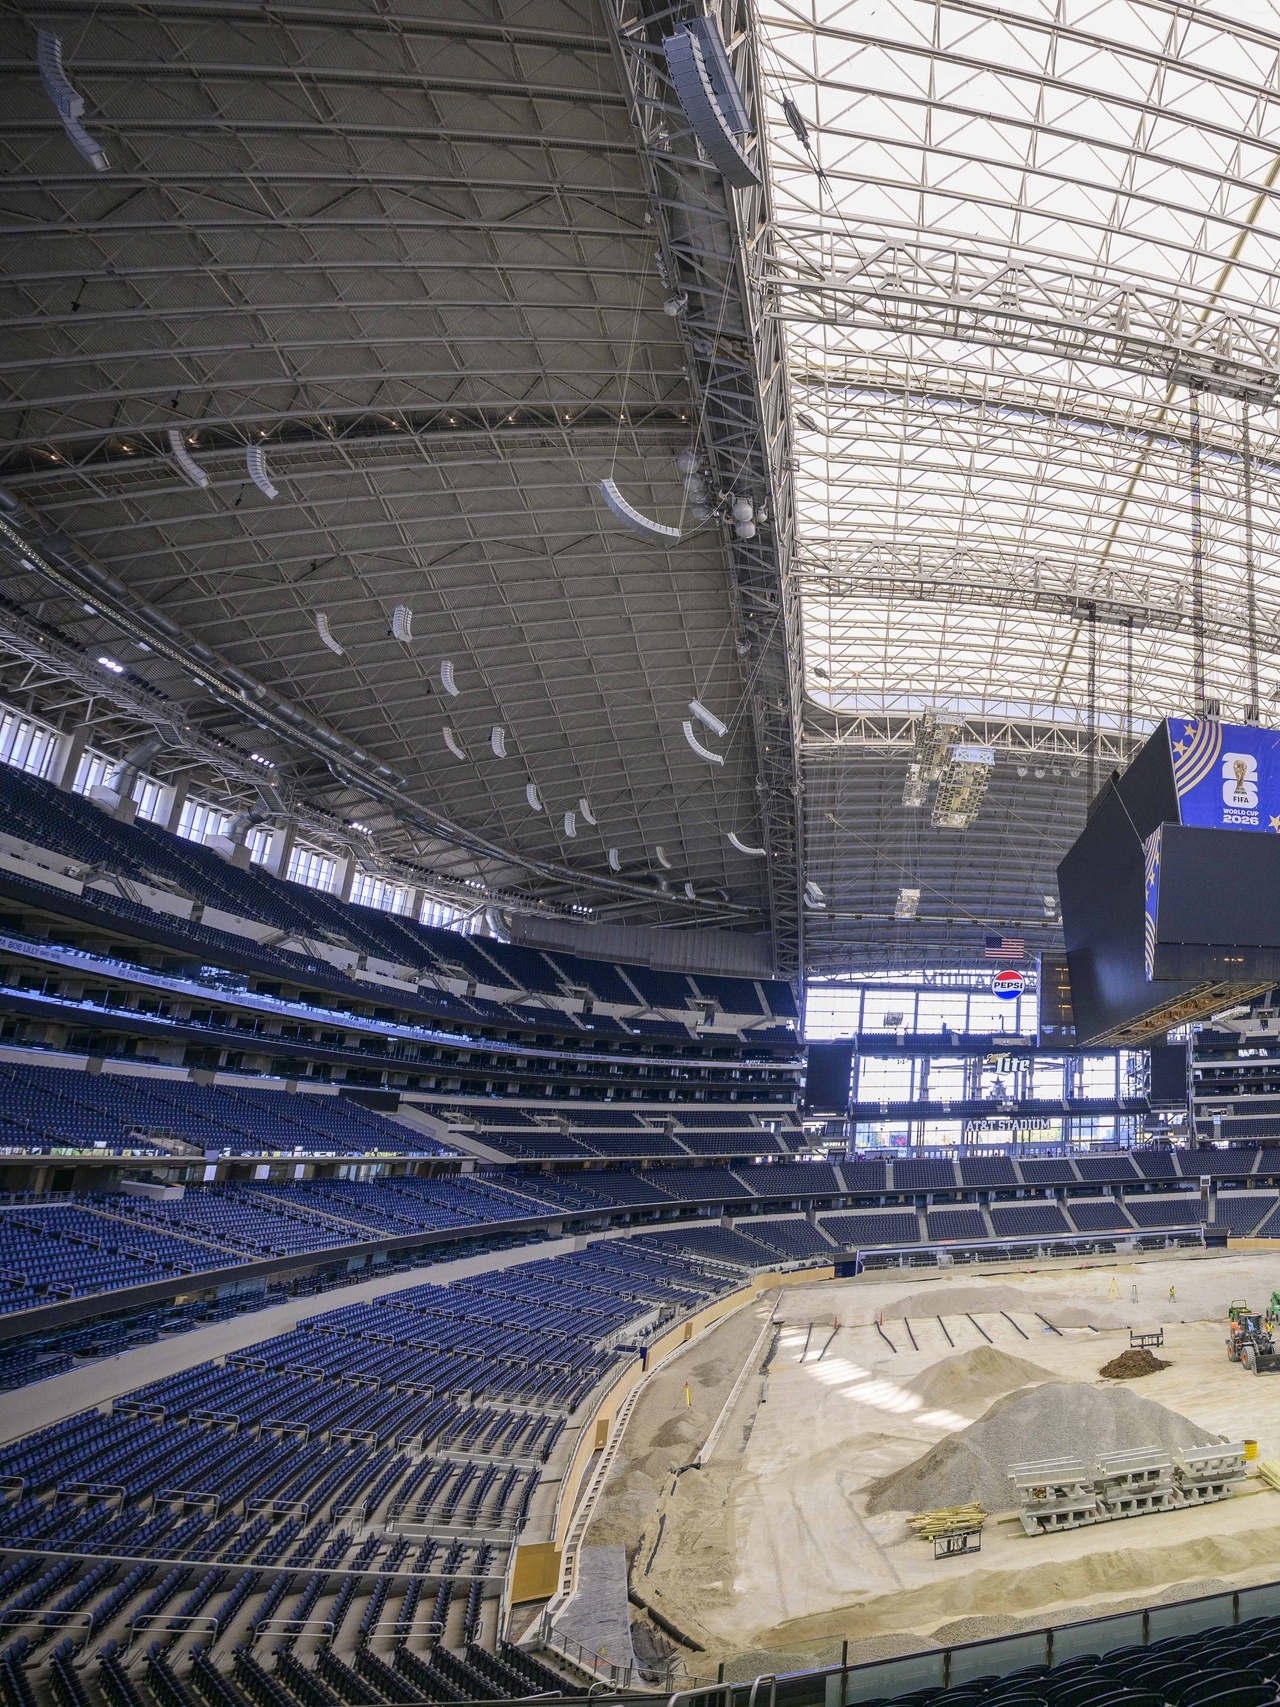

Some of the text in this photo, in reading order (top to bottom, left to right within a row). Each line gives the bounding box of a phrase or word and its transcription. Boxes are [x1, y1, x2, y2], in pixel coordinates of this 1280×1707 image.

[1233, 796, 1249, 804] FIFA
[1223, 808, 1246, 816] WORLD
[1223, 814, 1260, 826] 2026
[8, 941, 22, 951] BOB
[23, 944, 40, 955] LILLY
[994, 981, 1023, 989] PEPSI
[994, 1057, 1031, 1076] Lite
[965, 1118, 1051, 1132] AT&T STADIUM
